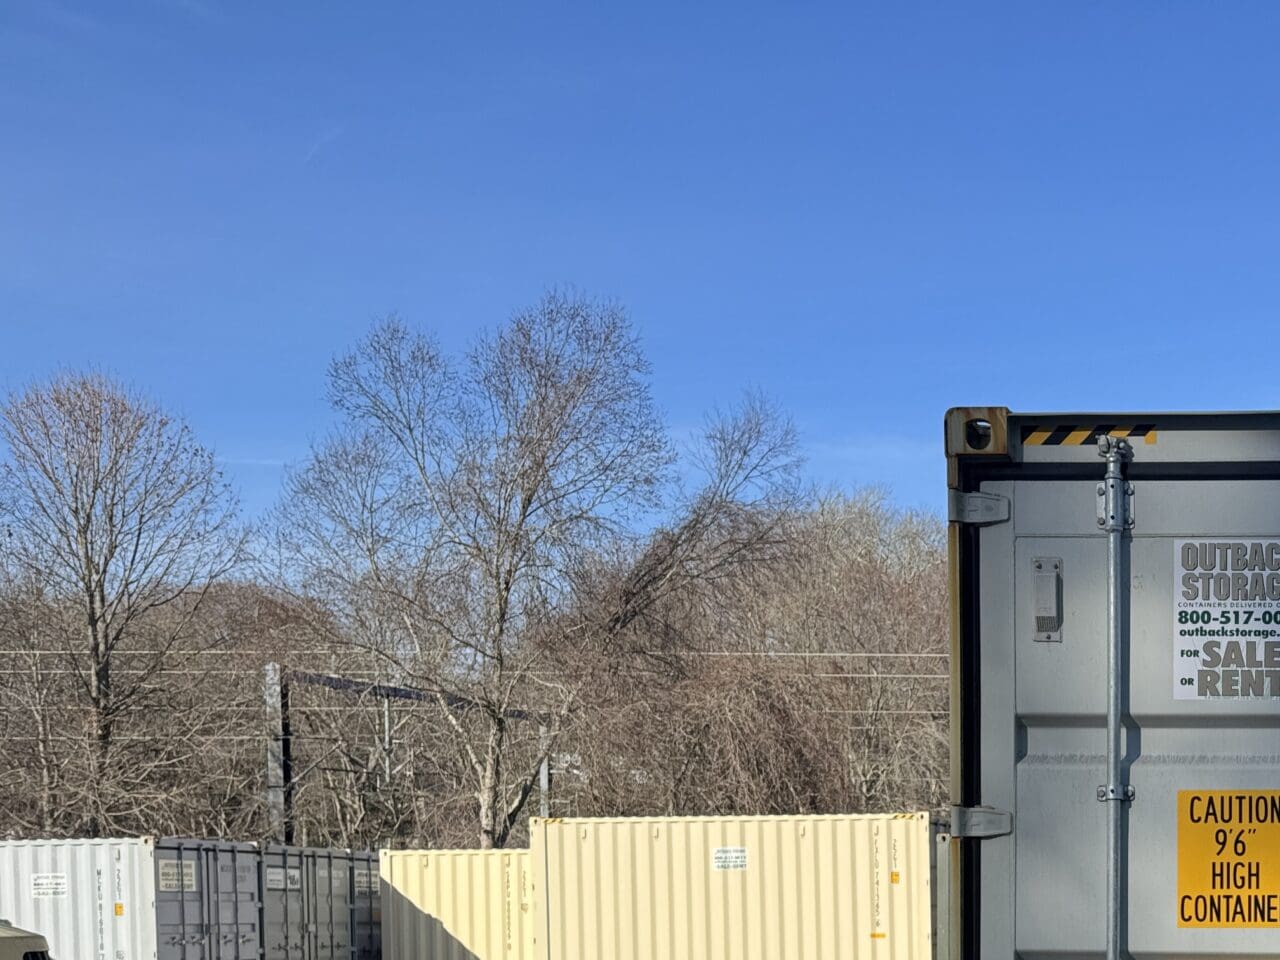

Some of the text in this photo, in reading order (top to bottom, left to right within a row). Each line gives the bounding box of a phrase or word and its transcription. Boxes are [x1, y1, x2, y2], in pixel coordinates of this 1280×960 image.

[1180, 649, 1200, 658] FOR
[1180, 677, 1194, 686] OR
[1211, 861, 1260, 890] HIGH
